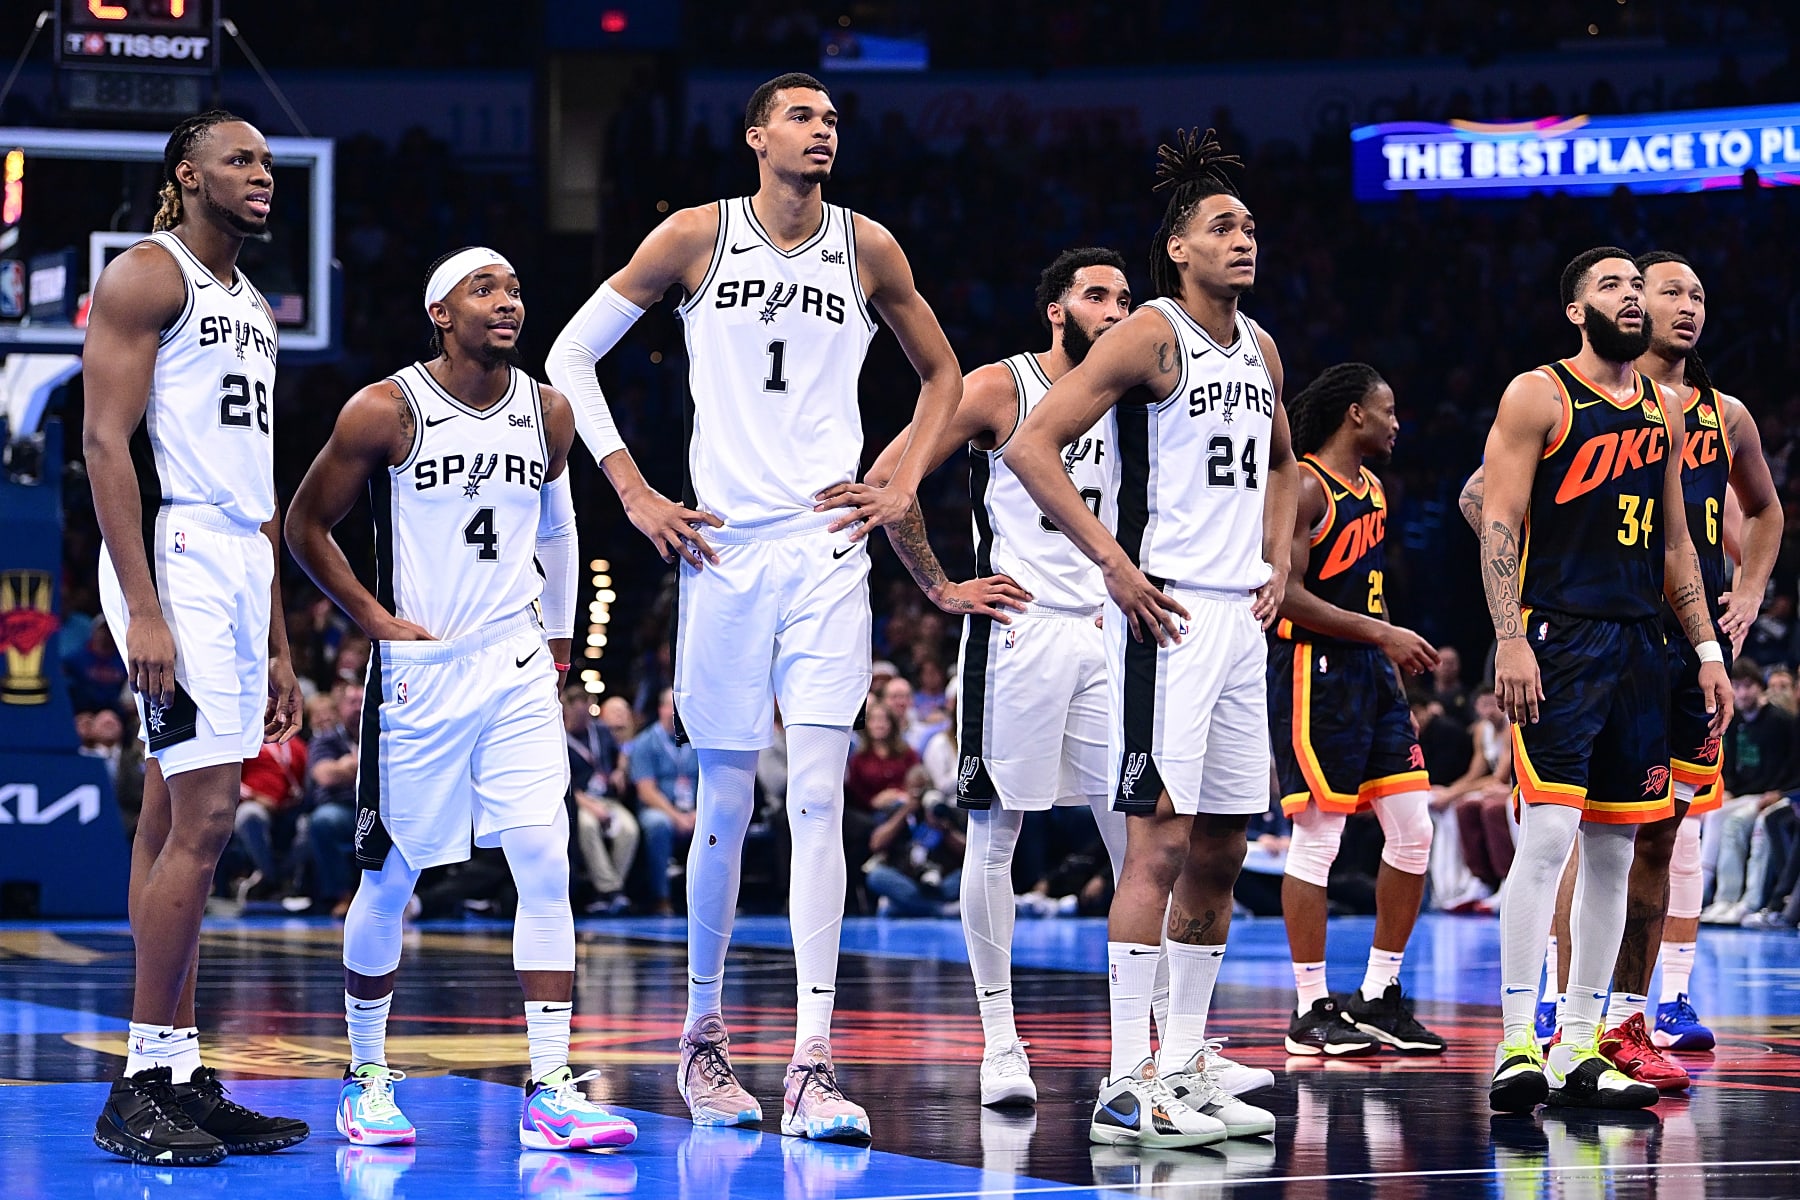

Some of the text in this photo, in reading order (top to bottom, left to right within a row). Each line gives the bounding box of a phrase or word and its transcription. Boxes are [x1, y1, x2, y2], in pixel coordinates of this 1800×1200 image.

[105, 33, 211, 60] TISSOT
[1383, 142, 1464, 181] THE
[1470, 138, 1568, 179] BEST
[1573, 132, 1694, 175] PLACE
[1700, 129, 1753, 168] TO
[715, 279, 846, 326] SPURS
[763, 338, 790, 394] 1
[218, 371, 270, 438] 28
[507, 414, 534, 429] Self.
[1188, 381, 1273, 425] SPURS
[414, 453, 544, 500] SPURS
[1205, 433, 1260, 492] 24
[1554, 426, 1665, 505] OKC
[1679, 430, 1718, 475] KC
[462, 506, 500, 563] 4
[1318, 509, 1385, 581] OKC
[1617, 494, 1655, 549] 34
[1705, 497, 1719, 545] 6
